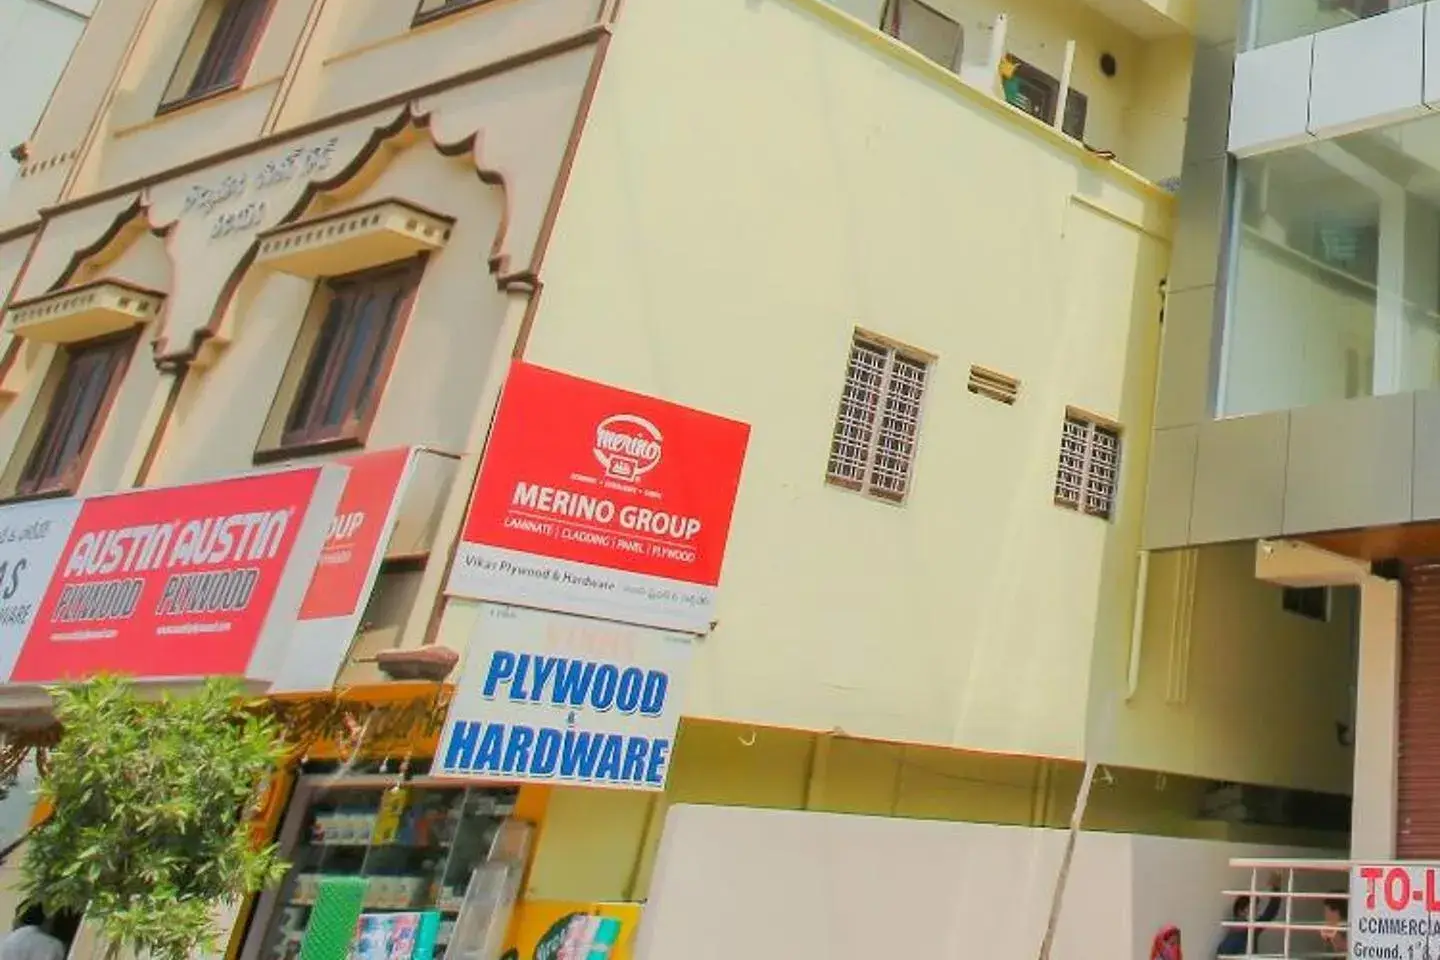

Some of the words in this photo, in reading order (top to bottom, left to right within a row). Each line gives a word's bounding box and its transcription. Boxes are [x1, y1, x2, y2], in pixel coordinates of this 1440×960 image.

[513, 481, 615, 523] MERINO
[619, 505, 701, 539] GROUP
[64, 523, 176, 578] AUSTIN
[167, 507, 291, 568] AUSTIN
[51, 577, 146, 623] PLYWOOD
[155, 567, 260, 616] PLYWOOD
[498, 559, 550, 581] Plywood
[561, 570, 616, 591] Hardware
[481, 649, 670, 718] PLYWOOD
[442, 719, 670, 785] HARDWARE
